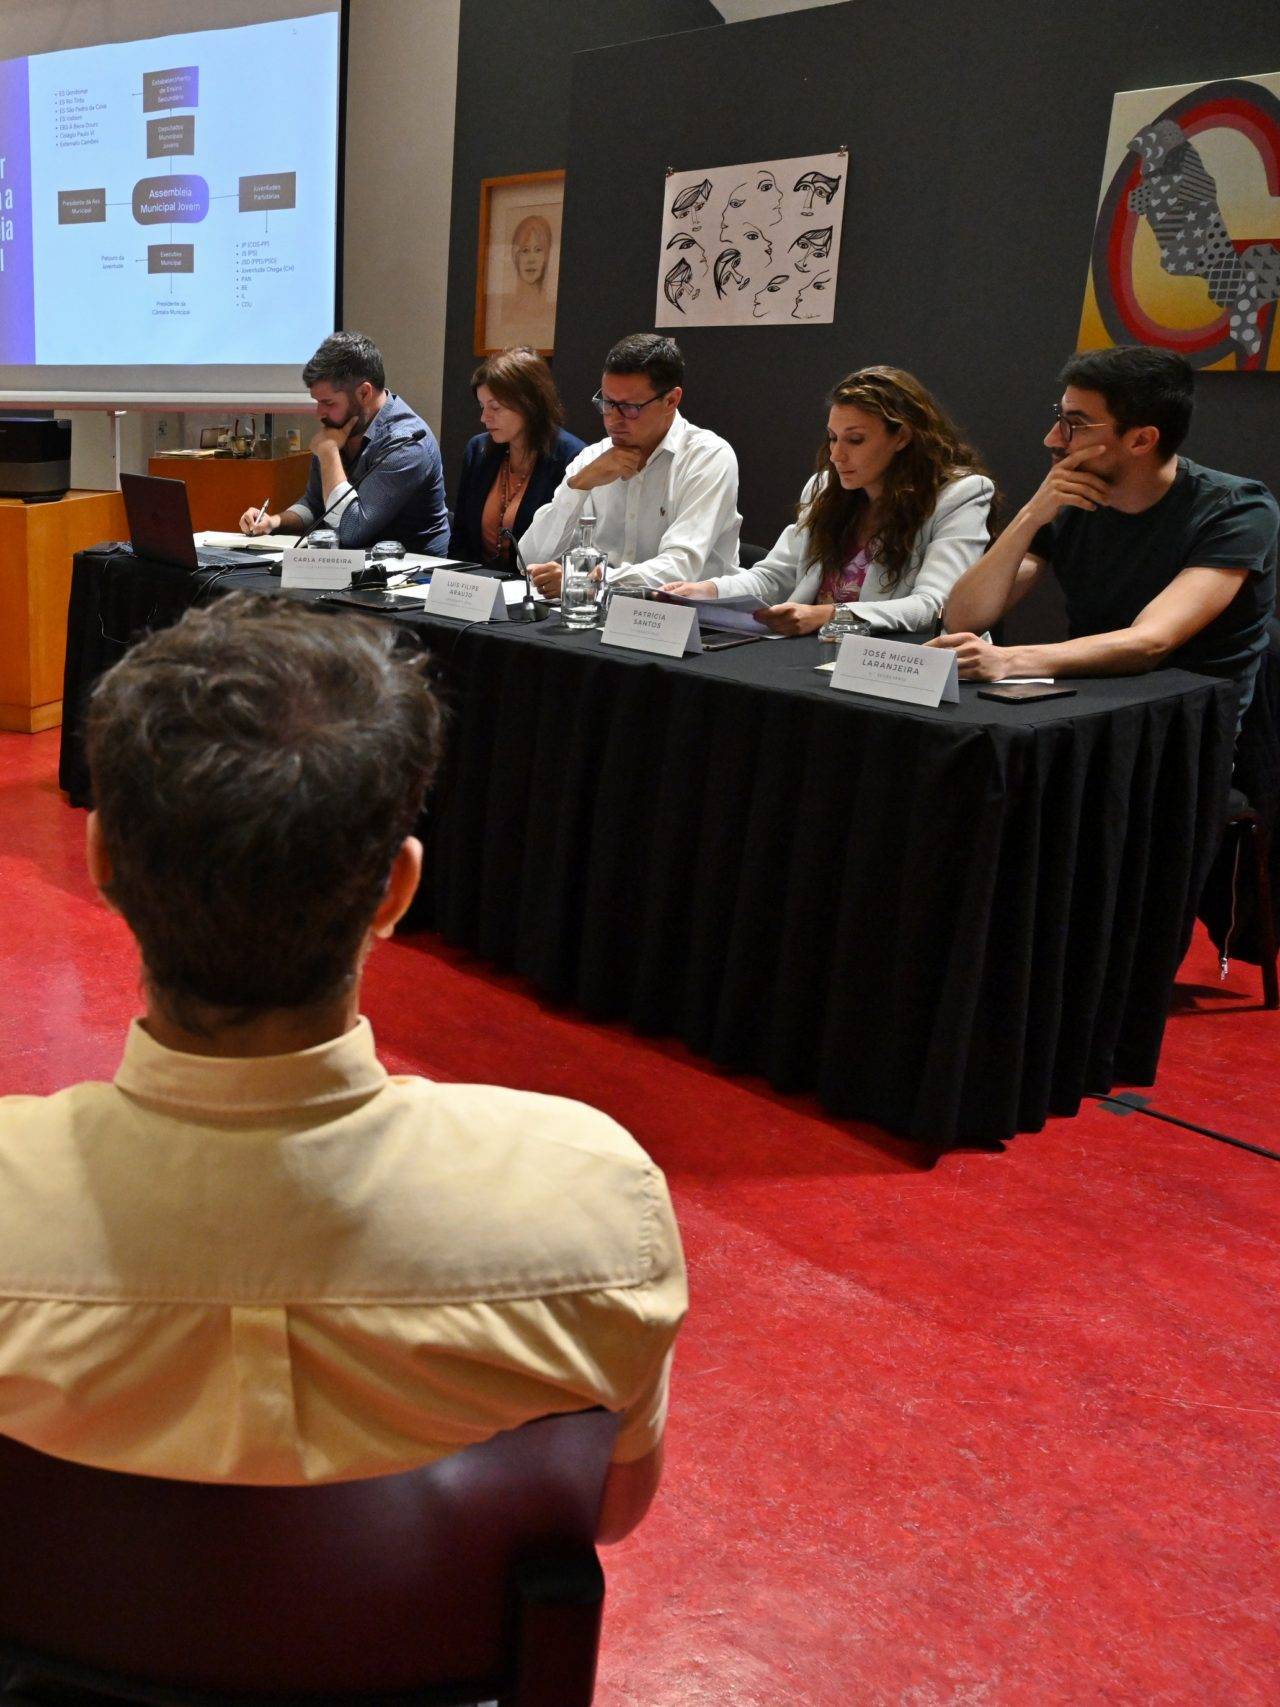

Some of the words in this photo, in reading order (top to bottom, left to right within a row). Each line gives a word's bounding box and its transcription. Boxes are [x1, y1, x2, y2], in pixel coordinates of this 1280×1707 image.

[5, 189, 13, 210] a
[149, 187, 192, 200] Assembleia
[140, 202, 176, 214] Municipal
[178, 202, 200, 212] Jovem
[633, 619, 661, 629] SANTOS
[863, 648, 885, 659] JOSÉ
[889, 653, 925, 666] MIGUEL
[862, 659, 920, 676] LARANJEIRA
